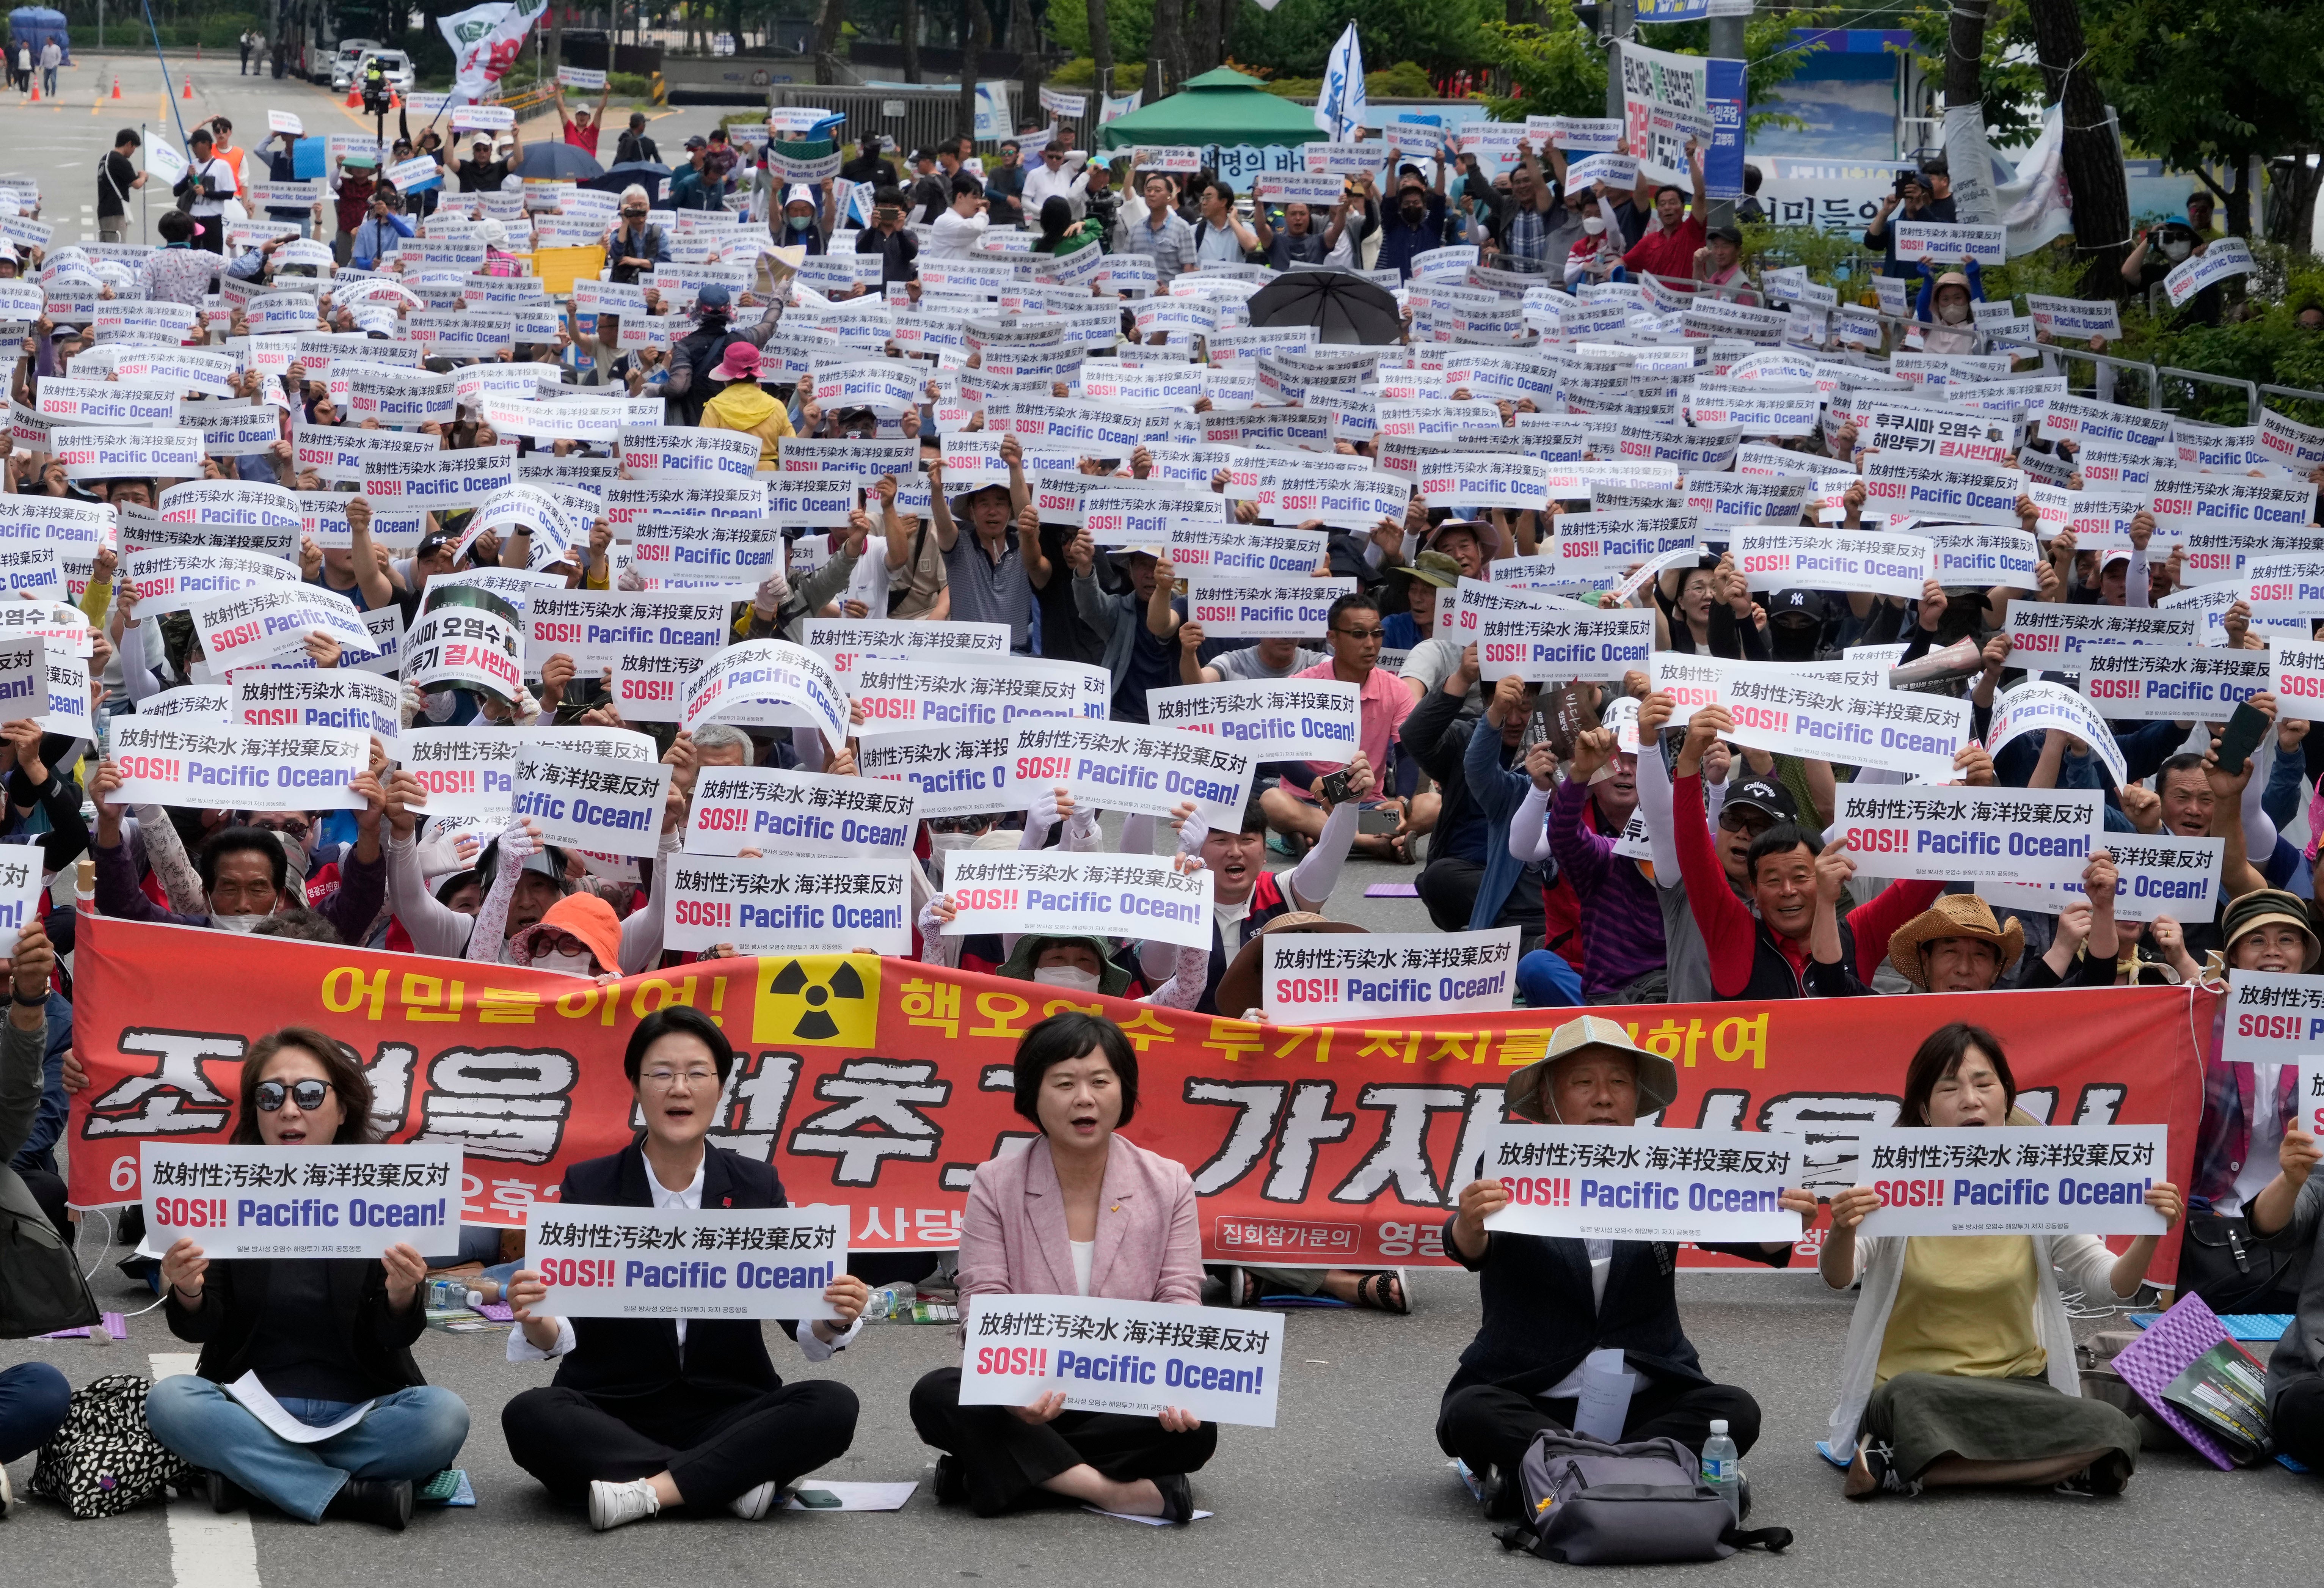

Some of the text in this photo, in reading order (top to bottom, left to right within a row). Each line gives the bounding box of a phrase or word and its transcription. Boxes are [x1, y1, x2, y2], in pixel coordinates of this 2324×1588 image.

[1275, 150, 1305, 172] 바
[1901, 240, 1999, 253] SOS!! Pacific Ocean!
[410, 318, 511, 329] 放射性汚染水 海洋投棄反対
[411, 330, 509, 342] SOS!! Pacific Ocean!
[1875, 413, 1982, 439] 후쿠시마 오염수
[58, 435, 197, 446] 放射性汚染水 海洋投棄反対
[1873, 432, 2007, 463] 해양투기 결사반대!
[100, 451, 146, 463] Pacific
[152, 451, 197, 463] Ocean!
[1869, 463, 2018, 490] 放射性汚染水 海洋投棄反対
[1869, 482, 2016, 510] SOS!! Pacific Ocean!
[1171, 530, 1321, 553] 放射性汚染水 海洋投棄反対
[1173, 548, 1316, 571] SOS!! Pacific Ocean!
[442, 617, 500, 644] 오염수
[444, 644, 520, 686] 결사반대!
[1909, 681, 1926, 690] 방사성
[119, 729, 359, 757] 放射性汚染水 海洋投棄反対
[119, 756, 179, 781] SOS!!
[188, 762, 269, 787] Pacific
[1743, 781, 1776, 798] Callaway
[1845, 798, 2093, 824] 放射性汚染水 海洋投棄反対
[1846, 828, 2090, 857] SOS!! Pacific Ocean!
[308, 884, 326, 898] 영광군
[675, 869, 903, 894] 放射性汚染水 海洋投棄反対
[955, 864, 1204, 895] 放射性汚染水 海洋投棄反対
[676, 900, 901, 928] SOS!! Pacific Ocean!
[956, 889, 1200, 924] SOS!! Pacific Ocean!
[1274, 942, 1511, 969] 放射性汚染水 海洋投棄反対
[1277, 971, 1505, 1003] SOS!! Pacific Ocean!
[322, 966, 727, 1028] 어민들이여!
[1202, 1018, 1335, 1063] 투기
[1357, 1027, 1553, 1067] 저지를
[1627, 1012, 1770, 1069] 하여
[1497, 1142, 1790, 1175] 放射性汚染水 海洋投棄反対
[1871, 1142, 2155, 1169] 放射性汚染水 海洋投棄反対
[152, 1161, 450, 1187] 放射性汚染水 海洋投棄反対
[1581, 1180, 1678, 1209] Pacific
[1875, 1180, 1944, 1207] SOS!!
[1954, 1179, 2049, 1205] Pacific
[156, 1197, 445, 1227] SOS!! Pacific Ocean!
[538, 1221, 836, 1250] 放射性汚染水 海洋投棄反対
[1223, 1223, 1351, 1247] 집회참가문의
[540, 1258, 615, 1287] SOS!!
[626, 1261, 726, 1288] Pacific
[978, 1312, 1269, 1354] 放射性汚染水 海洋投棄反対
[978, 1347, 1263, 1394] SOS!! Pacific Ocean!
